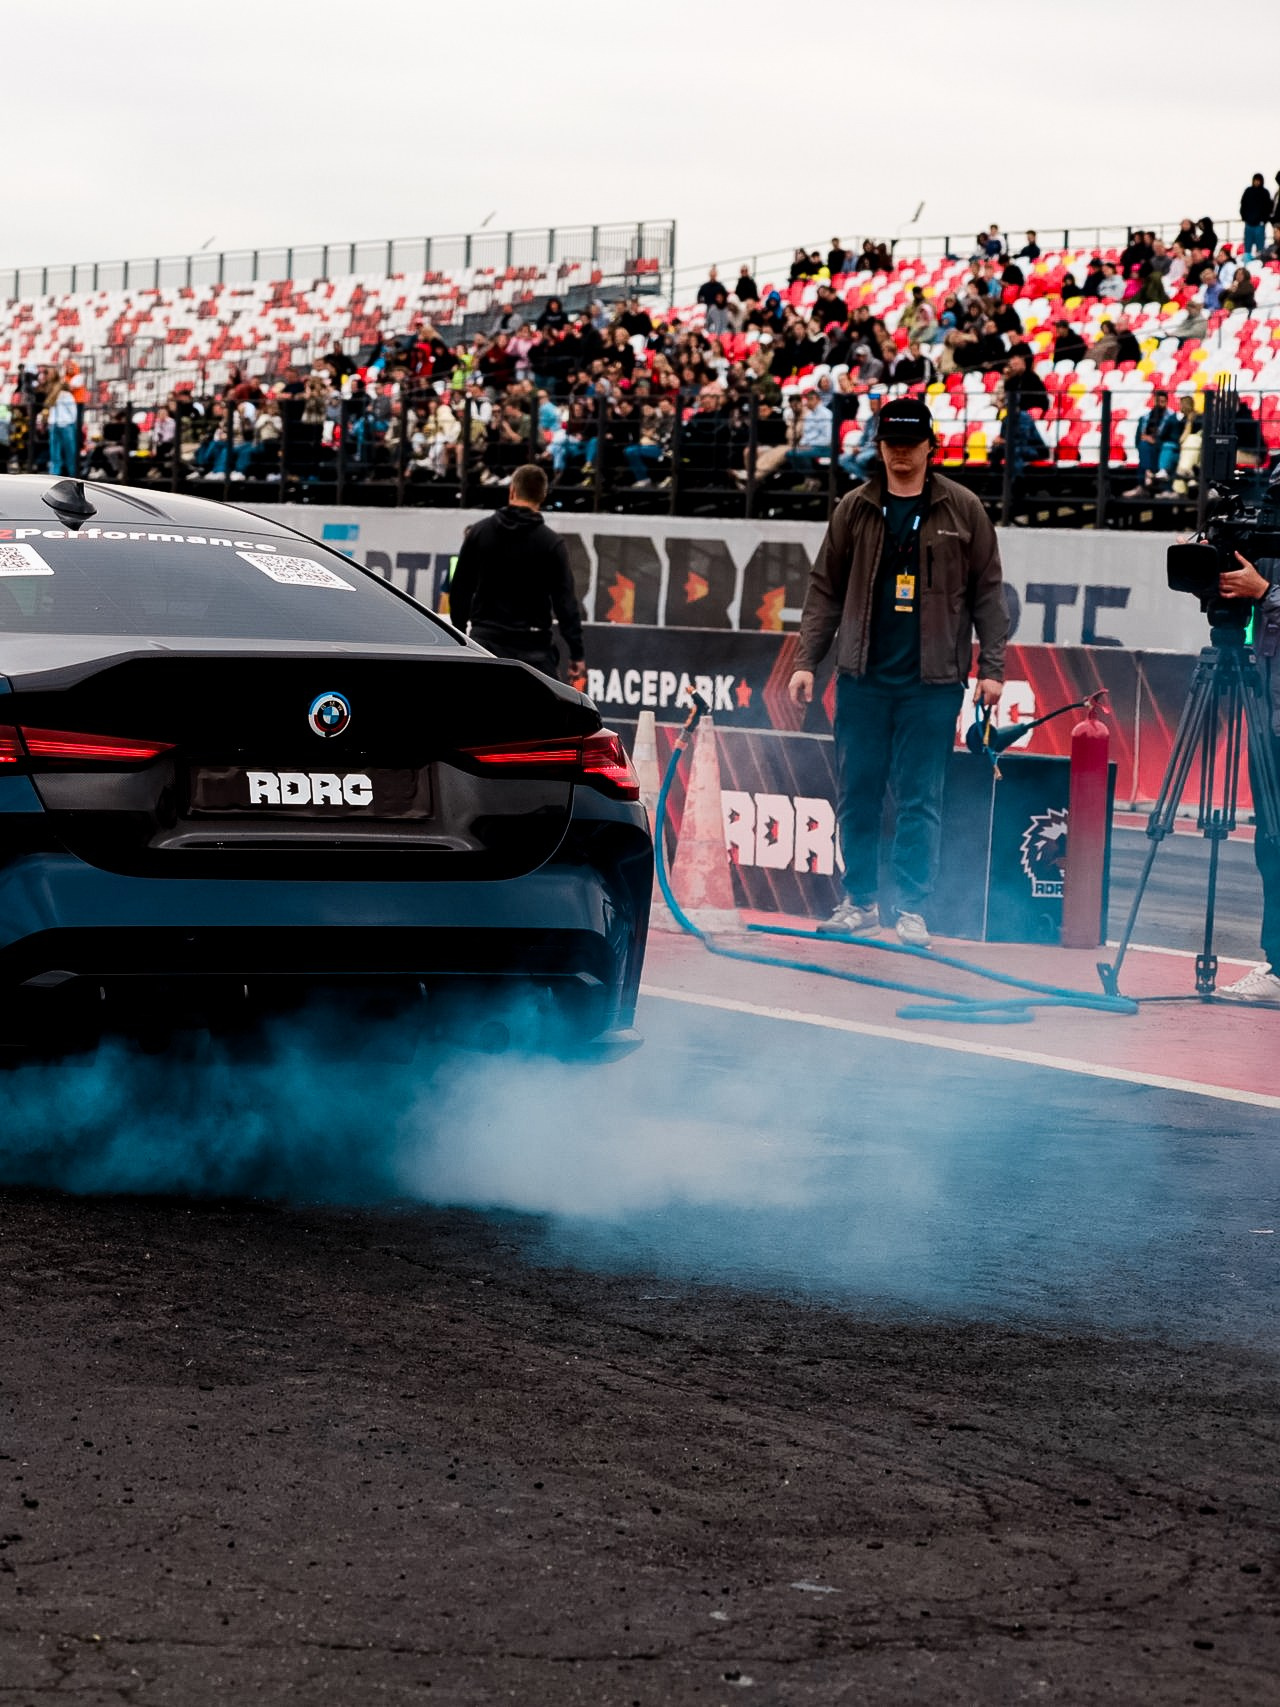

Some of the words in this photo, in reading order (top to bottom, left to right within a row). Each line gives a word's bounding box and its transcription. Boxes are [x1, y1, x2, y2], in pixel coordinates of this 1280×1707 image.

[558, 533, 819, 632] DRC
[587, 668, 735, 711] RACEPARK
[246, 772, 373, 806] RDRC
[721, 790, 845, 876] RDR
[1035, 884, 1063, 894] RDR
